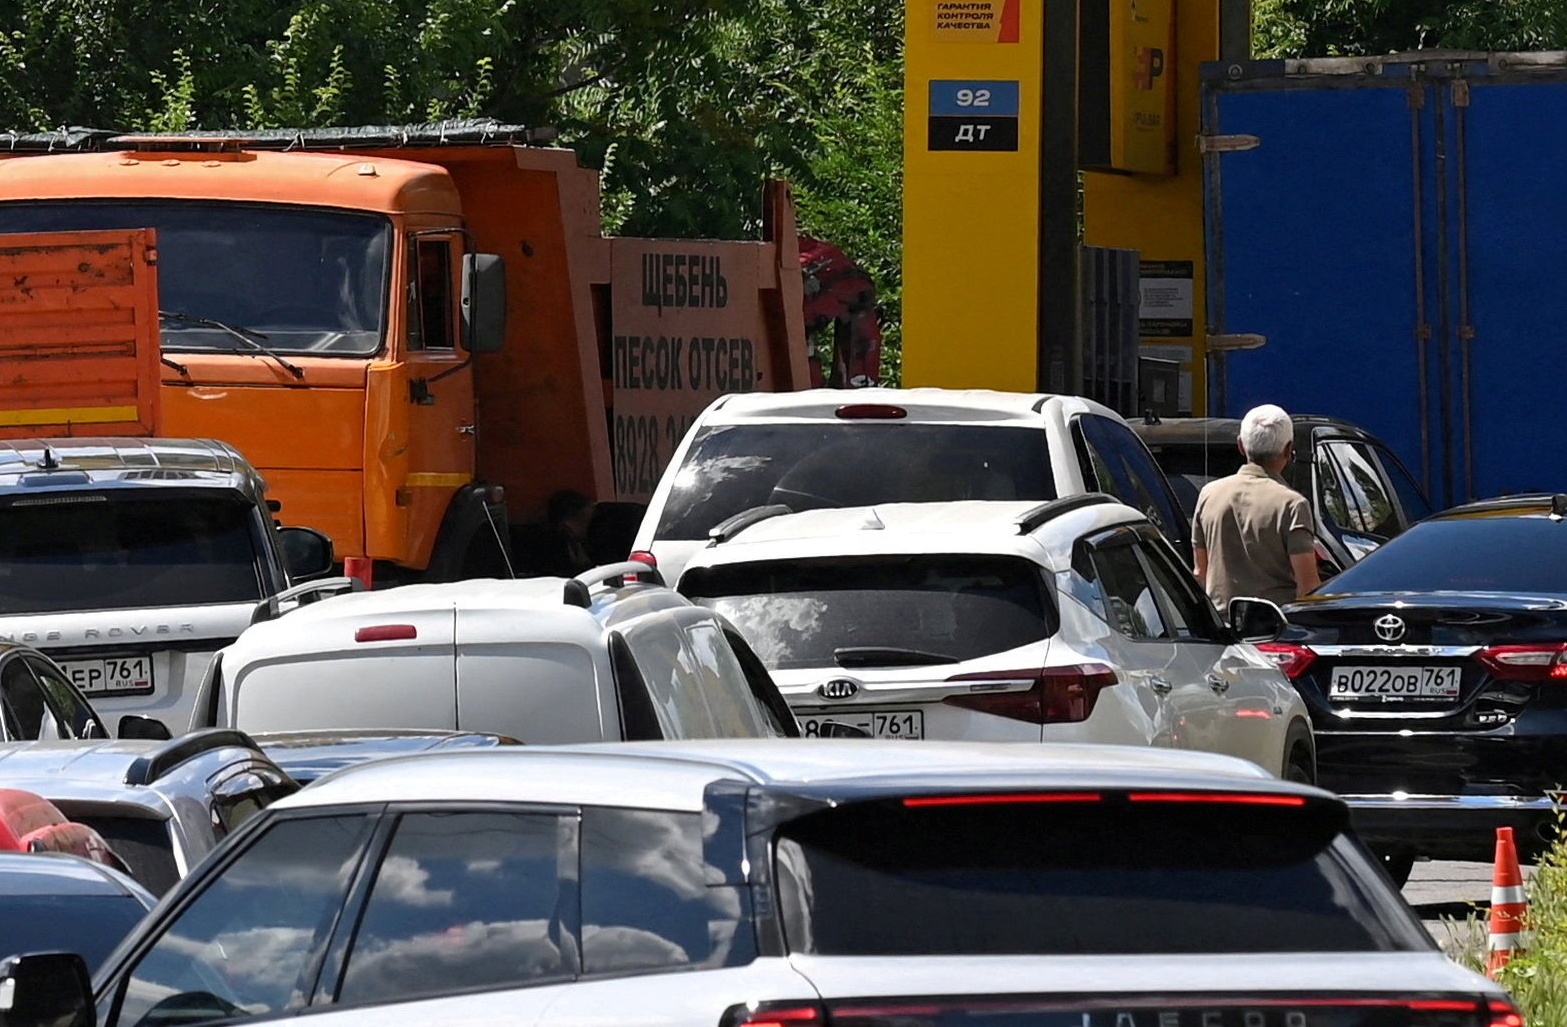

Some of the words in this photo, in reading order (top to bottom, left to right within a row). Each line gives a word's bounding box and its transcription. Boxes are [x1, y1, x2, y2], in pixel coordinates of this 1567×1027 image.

[956, 89, 991, 107] 92
[955, 125, 992, 143] ДТ
[642, 253, 728, 317] ЩЕБЕНЬ
[614, 336, 683, 391] ПЕСОК
[689, 336, 754, 392] ОТСЕВ
[85, 624, 194, 640] ROVER
[107, 660, 143, 680] 761
[116, 680, 135, 688] RUS
[824, 682, 853, 697] KIA
[1337, 669, 1419, 693] В022ОВ
[1424, 669, 1455, 687] 761
[876, 714, 914, 735] 761
